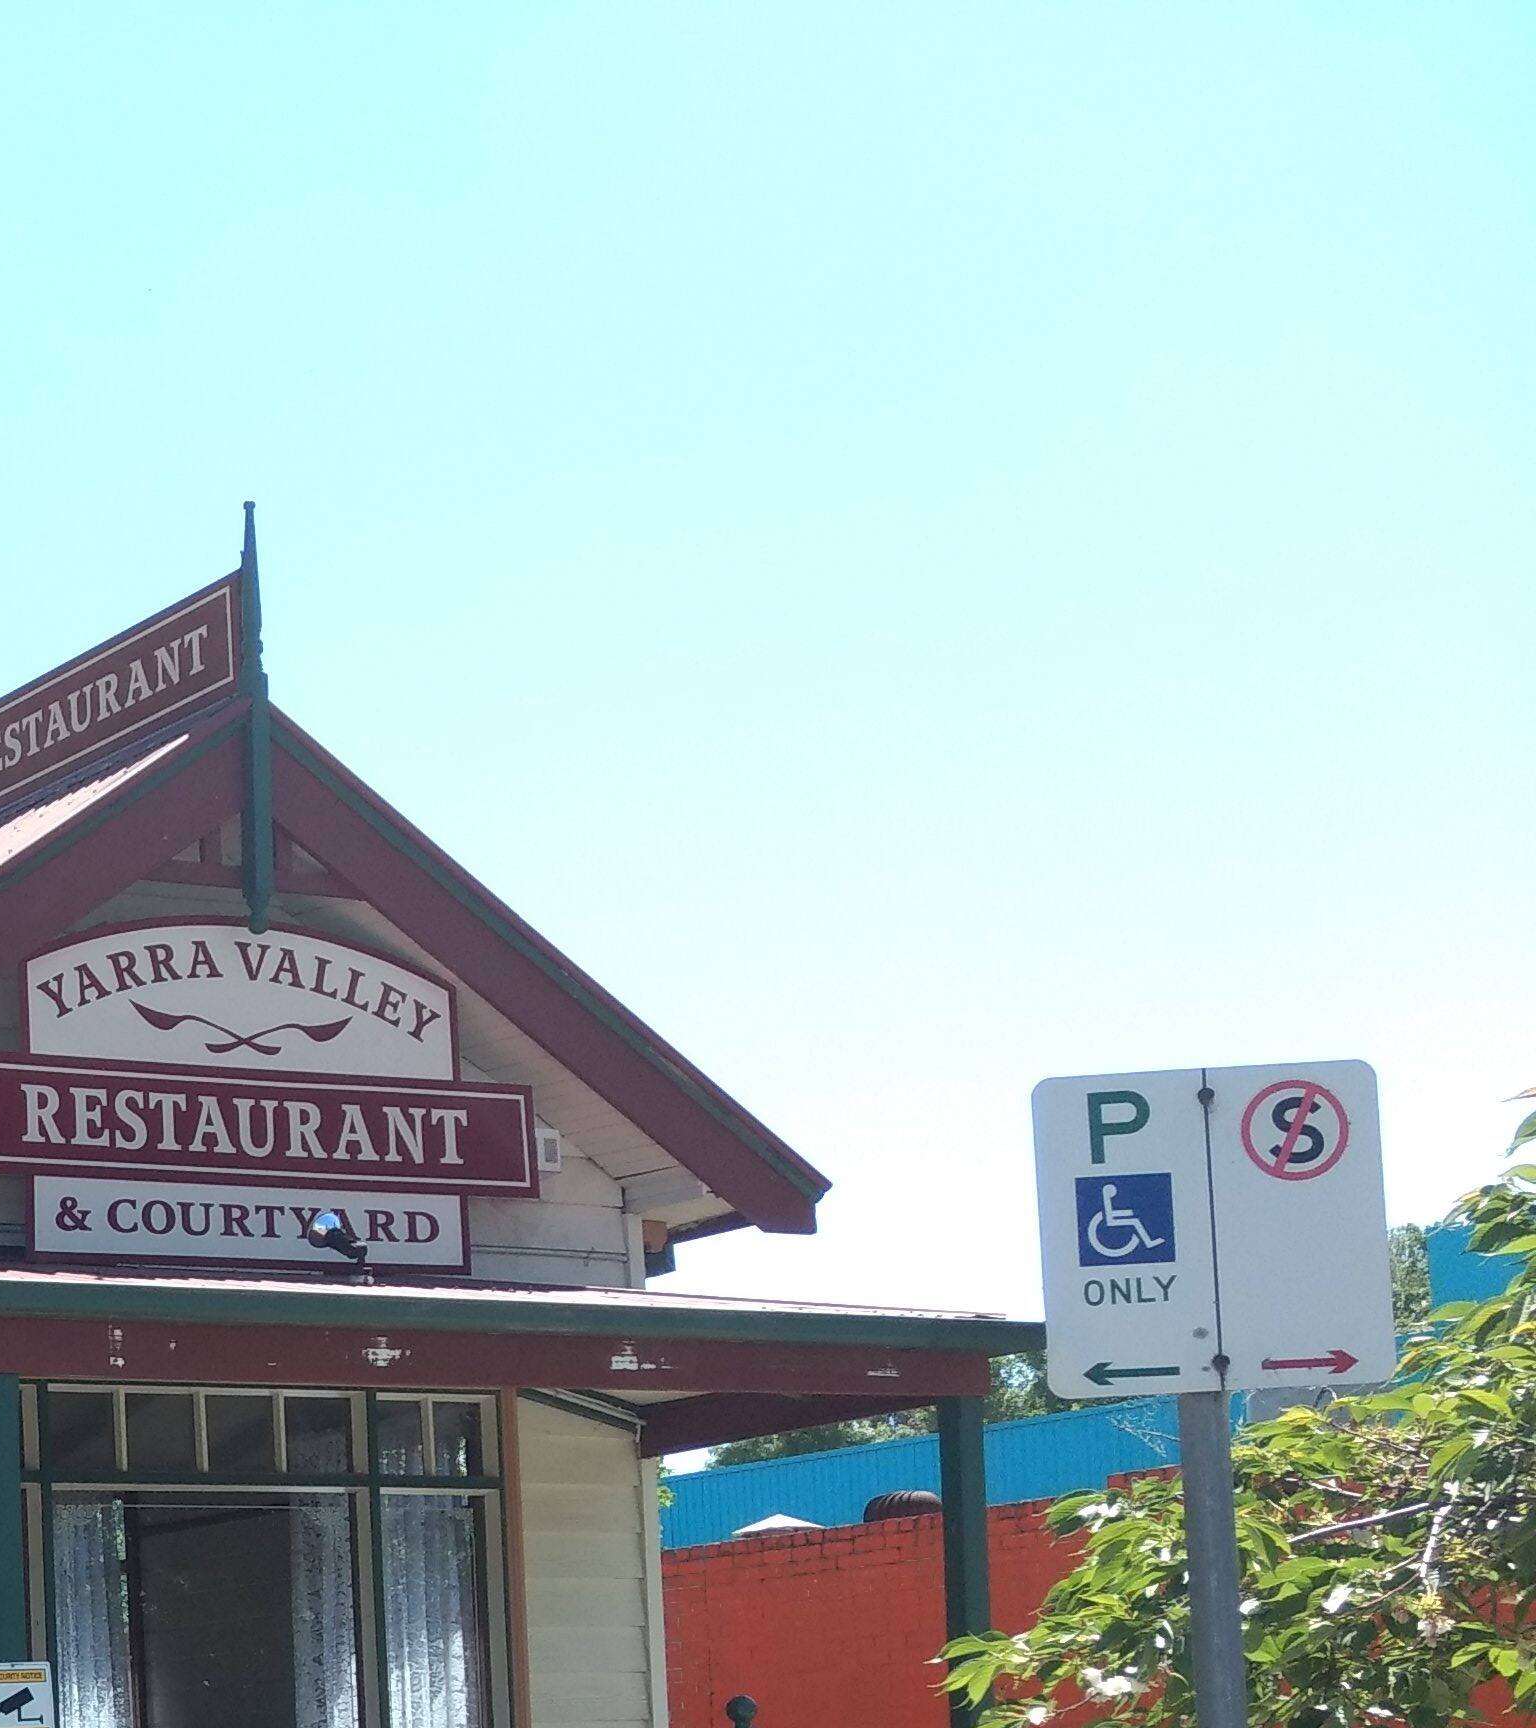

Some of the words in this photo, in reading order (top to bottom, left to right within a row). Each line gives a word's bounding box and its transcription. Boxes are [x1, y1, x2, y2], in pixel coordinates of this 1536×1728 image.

[36, 940, 224, 1020] YARRA
[233, 940, 443, 1044] VALLEY
[20, 1083, 469, 1166] RESTAURANT
[1087, 1090, 1150, 1164] P
[55, 1196, 92, 1233] &
[1083, 1274, 1178, 1307] ONLY
